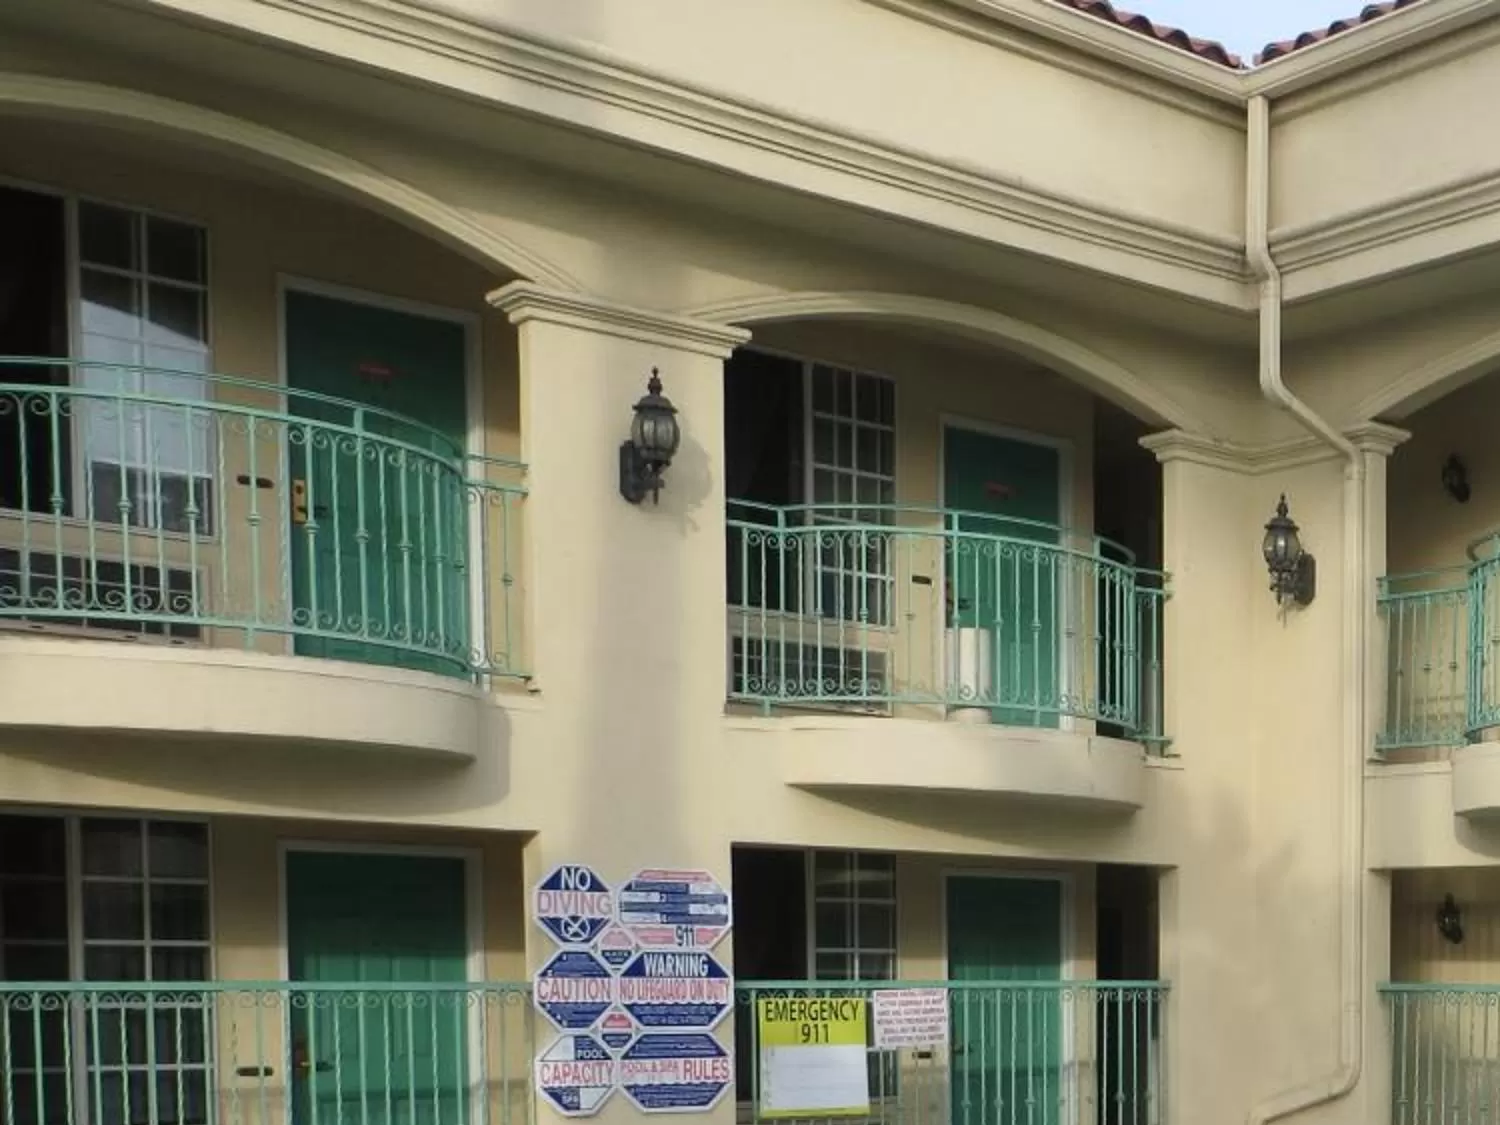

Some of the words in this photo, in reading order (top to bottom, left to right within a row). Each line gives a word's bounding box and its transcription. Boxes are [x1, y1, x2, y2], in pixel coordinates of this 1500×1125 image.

[561, 867, 591, 891] NO
[537, 892, 612, 914] DIVING
[675, 926, 695, 947] 911
[643, 953, 709, 977] WARNING
[537, 979, 611, 1001] CAUTION
[620, 979, 635, 1000] NO
[690, 979, 704, 1000] ON
[764, 999, 860, 1023] EMERGENCY
[801, 1023, 830, 1044] 911
[577, 1049, 606, 1059] POOL
[539, 1062, 614, 1085] CAPACITY
[683, 1059, 730, 1081] RULES
